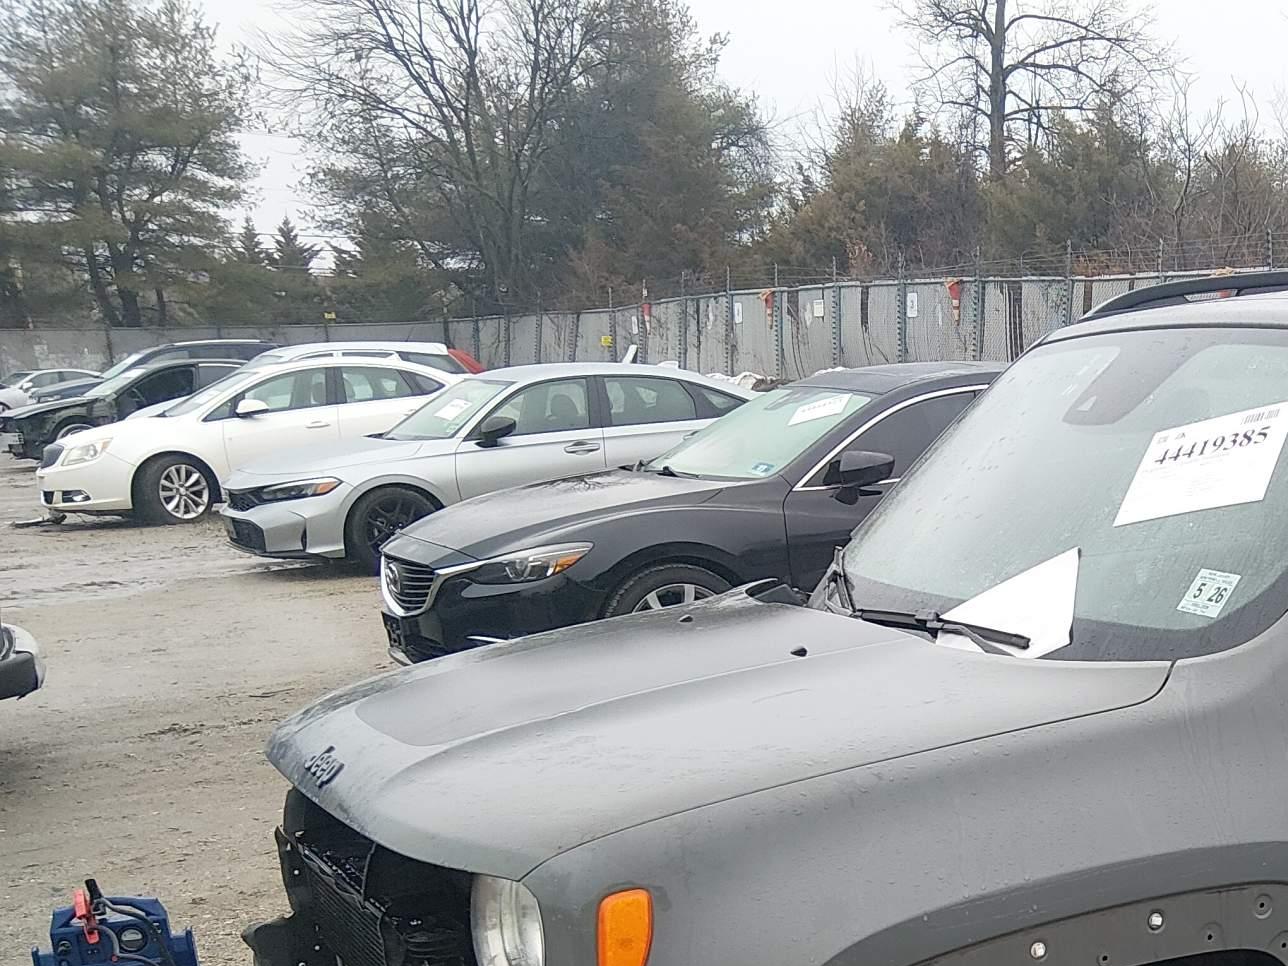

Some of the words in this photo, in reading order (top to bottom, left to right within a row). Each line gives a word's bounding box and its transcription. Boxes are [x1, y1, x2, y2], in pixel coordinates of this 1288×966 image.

[1154, 425, 1271, 465] 44419385
[1193, 582, 1207, 599] 5
[1206, 586, 1228, 604] 26
[304, 745, 345, 789] Jeep
